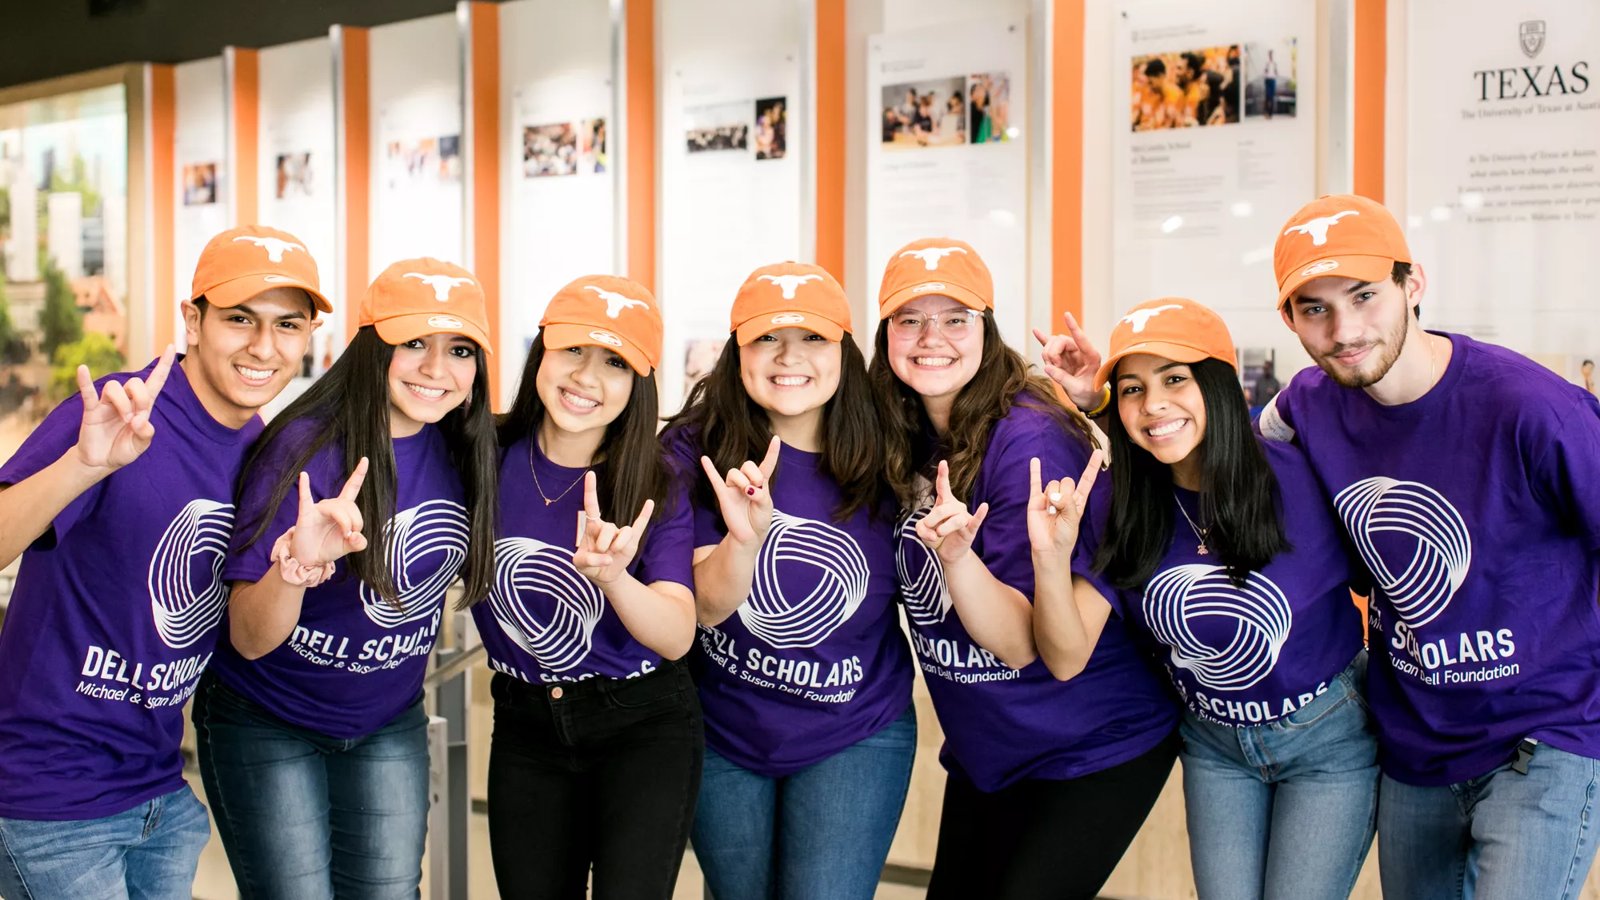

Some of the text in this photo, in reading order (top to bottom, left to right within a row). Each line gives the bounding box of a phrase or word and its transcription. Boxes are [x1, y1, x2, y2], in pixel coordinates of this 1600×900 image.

[1473, 61, 1590, 102] TEXAS
[288, 640, 334, 666] Michael
[334, 661, 345, 669] &
[291, 624, 350, 659] DELL
[911, 628, 1008, 668] SCHOLAR
[1391, 620, 1516, 670] SCHOLARS
[81, 645, 144, 691] DELL
[146, 651, 214, 691] SCHOLA
[700, 633, 856, 703] Michael & Susan Dell Foundati
[745, 648, 864, 688] SCHOLARS
[954, 668, 1020, 684] Foundation
[1388, 651, 1419, 677] usan
[1444, 663, 1520, 684] Foundation
[76, 681, 129, 702] Michael
[129, 693, 142, 704] &
[144, 697, 169, 709] Ssan
